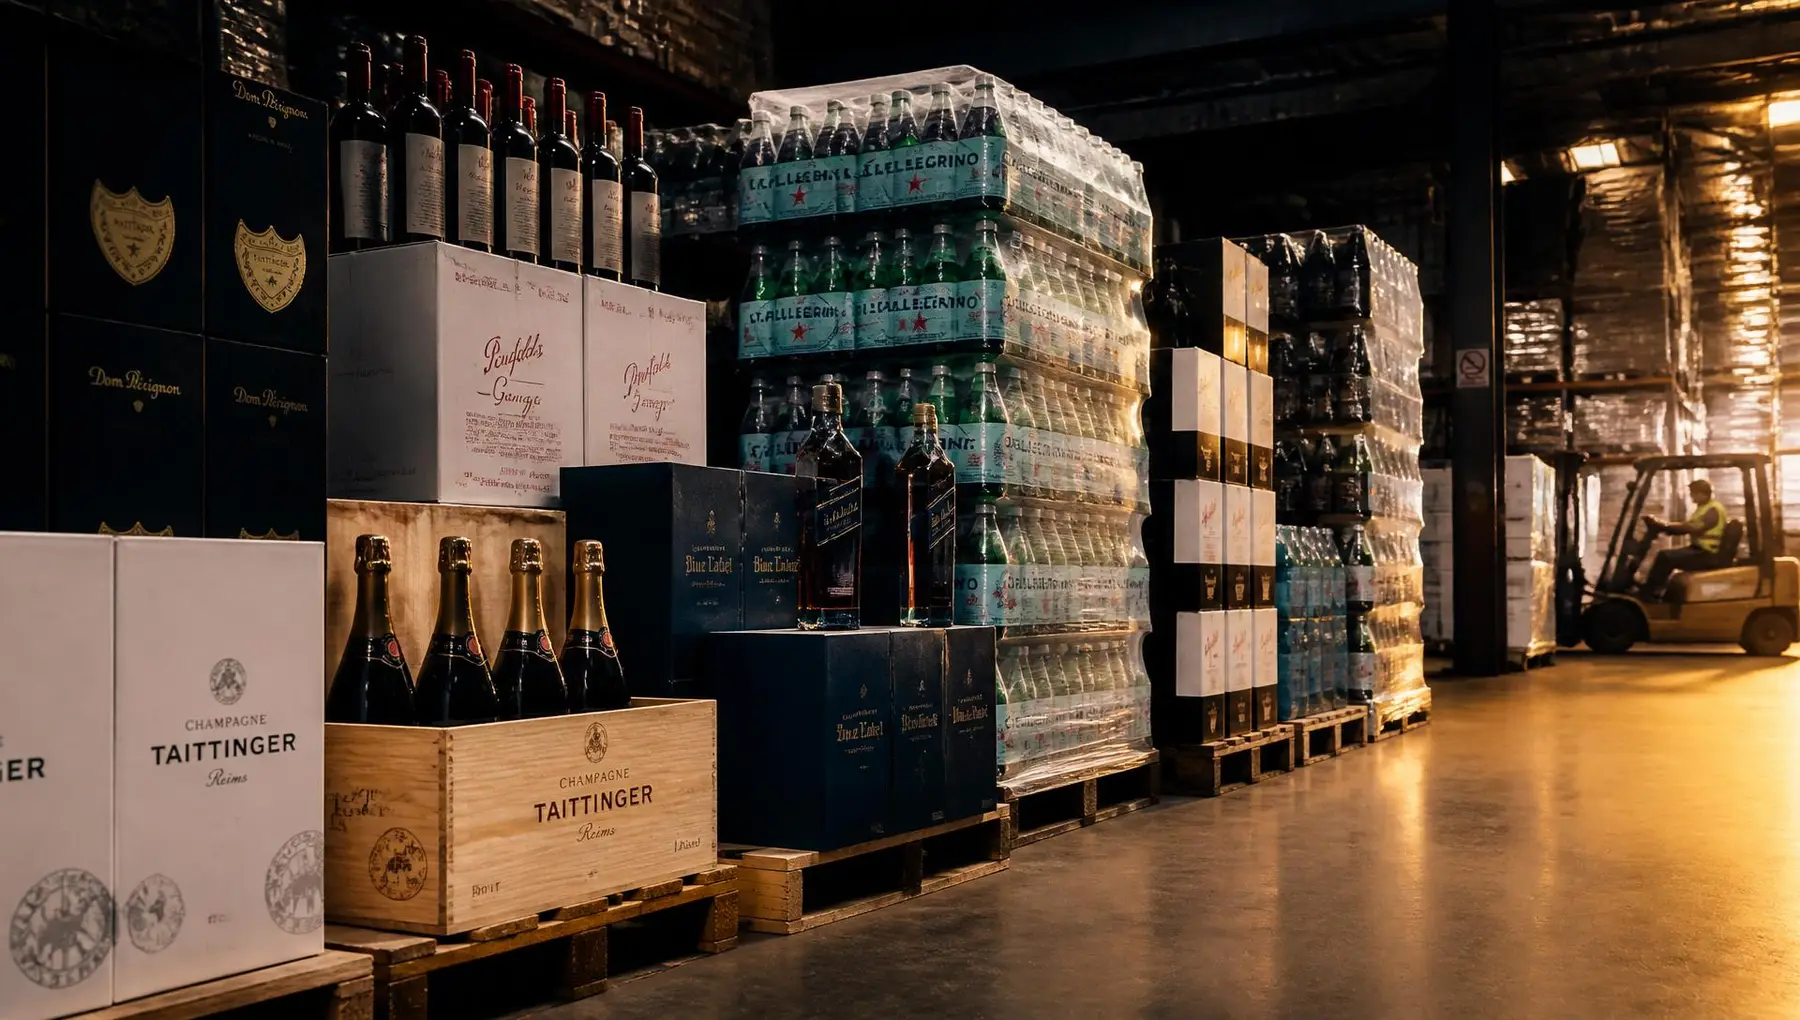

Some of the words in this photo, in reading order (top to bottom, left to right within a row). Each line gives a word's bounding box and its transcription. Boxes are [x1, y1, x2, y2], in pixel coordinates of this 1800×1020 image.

[232, 80, 260, 104] Dom
[88, 366, 123, 388] Dom
[233, 386, 260, 405] Dom
[185, 714, 268, 731] CHAMPAGNE
[151, 733, 297, 766] TAITTINGER
[205, 768, 248, 787] Reims
[559, 767, 630, 789] CHAMPAGNE
[534, 784, 653, 823] TAITTINGER
[576, 822, 616, 843] Reims
